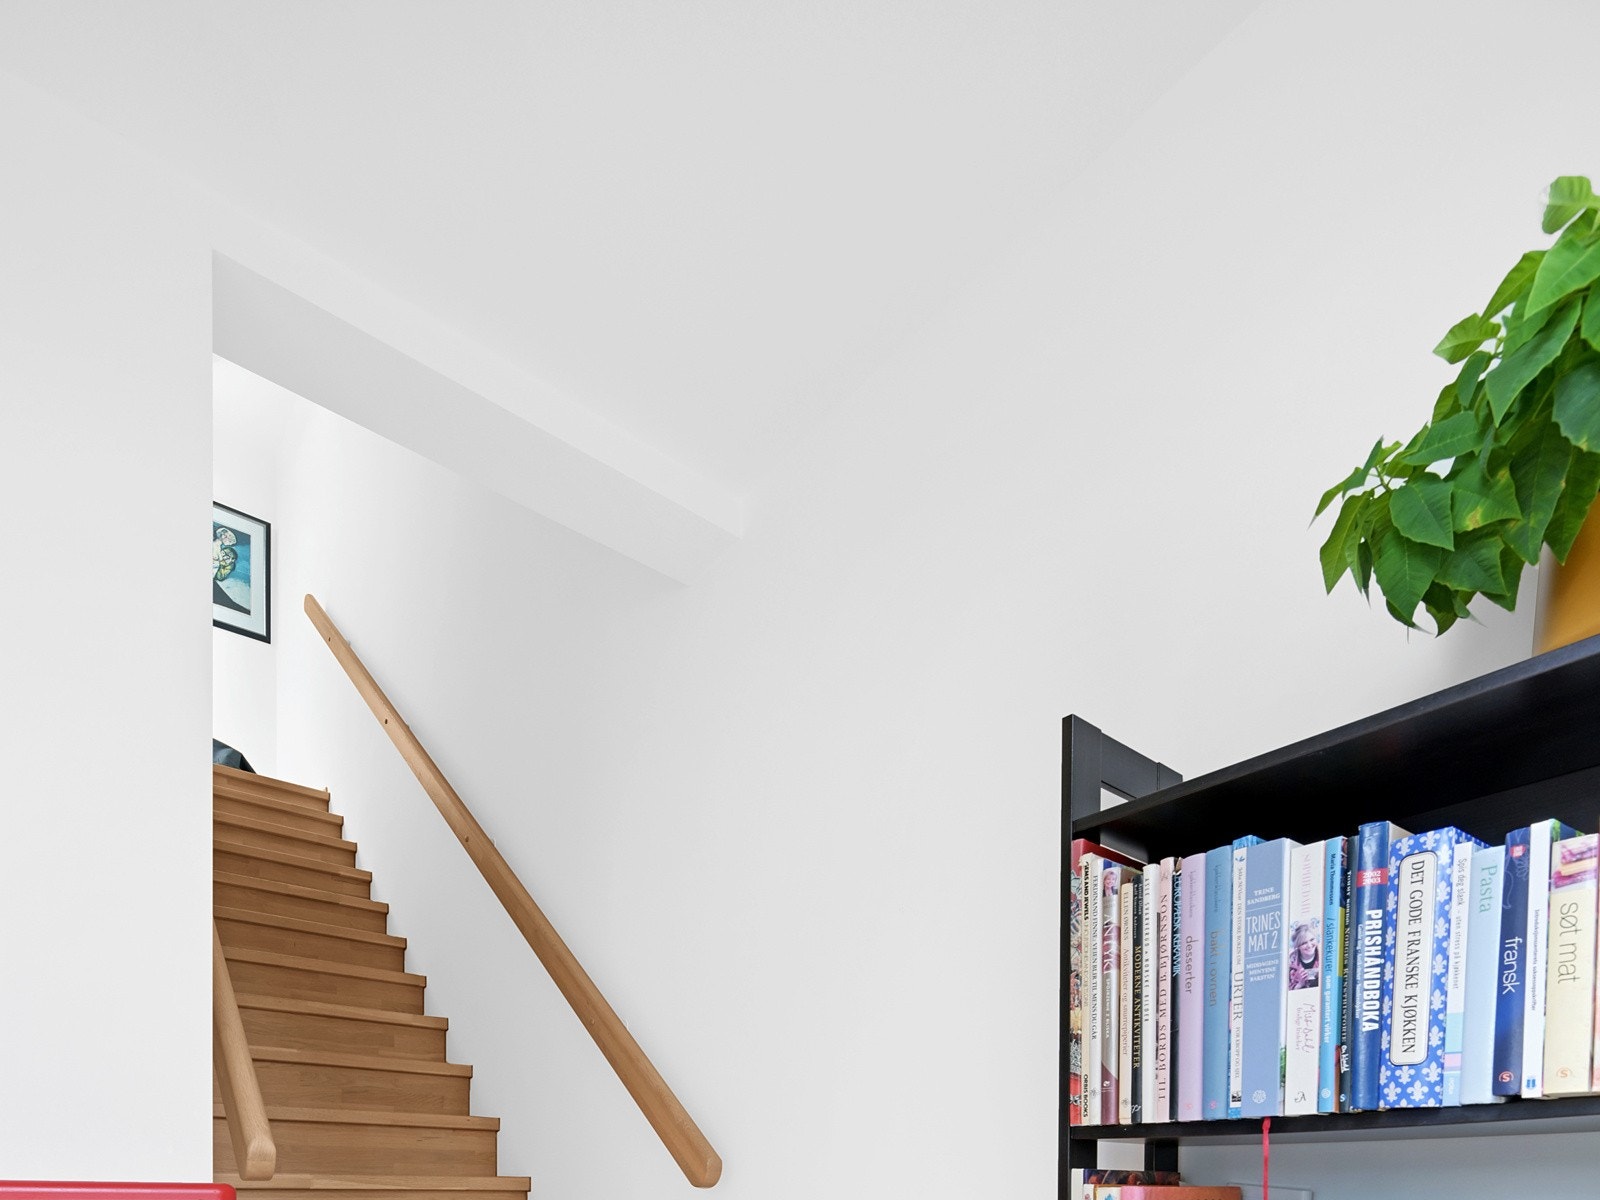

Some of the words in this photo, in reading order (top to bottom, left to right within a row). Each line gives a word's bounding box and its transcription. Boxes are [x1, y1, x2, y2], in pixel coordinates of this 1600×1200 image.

[1362, 870, 1381, 878] 2002
[1362, 877, 1381, 885] 2003
[1410, 860, 1425, 886] DET
[1456, 874, 1466, 887] deg
[1457, 858, 1467, 874] Spis
[1246, 893, 1281, 905] SANDBERG
[1253, 887, 1275, 897] TRINE
[1457, 888, 1466, 906] slank
[1478, 864, 1499, 914] Pasta
[1246, 912, 1281, 932] TRINES
[1408, 889, 1424, 926] GODE
[1558, 902, 1582, 937] søt
[1159, 894, 1170, 969] BJØRNSON
[1248, 933, 1271, 952] MAT
[1270, 931, 1279, 950] 2
[1134, 945, 1142, 995] MODERNE
[1185, 935, 1199, 994] desserter
[1362, 909, 1385, 1033] PRISHÅNDBOKA
[1405, 930, 1421, 990] FRANSKE
[1502, 937, 1523, 995] fransk
[1557, 943, 1581, 984] mat
[1158, 988, 1168, 1018] MED
[1209, 967, 1218, 1007] ovnen
[1232, 971, 1244, 1021] URTER
[1091, 1013, 1098, 1024] DU
[1400, 994, 1418, 1053] KJØKKEN
[1158, 1024, 1167, 1071] BORDS
